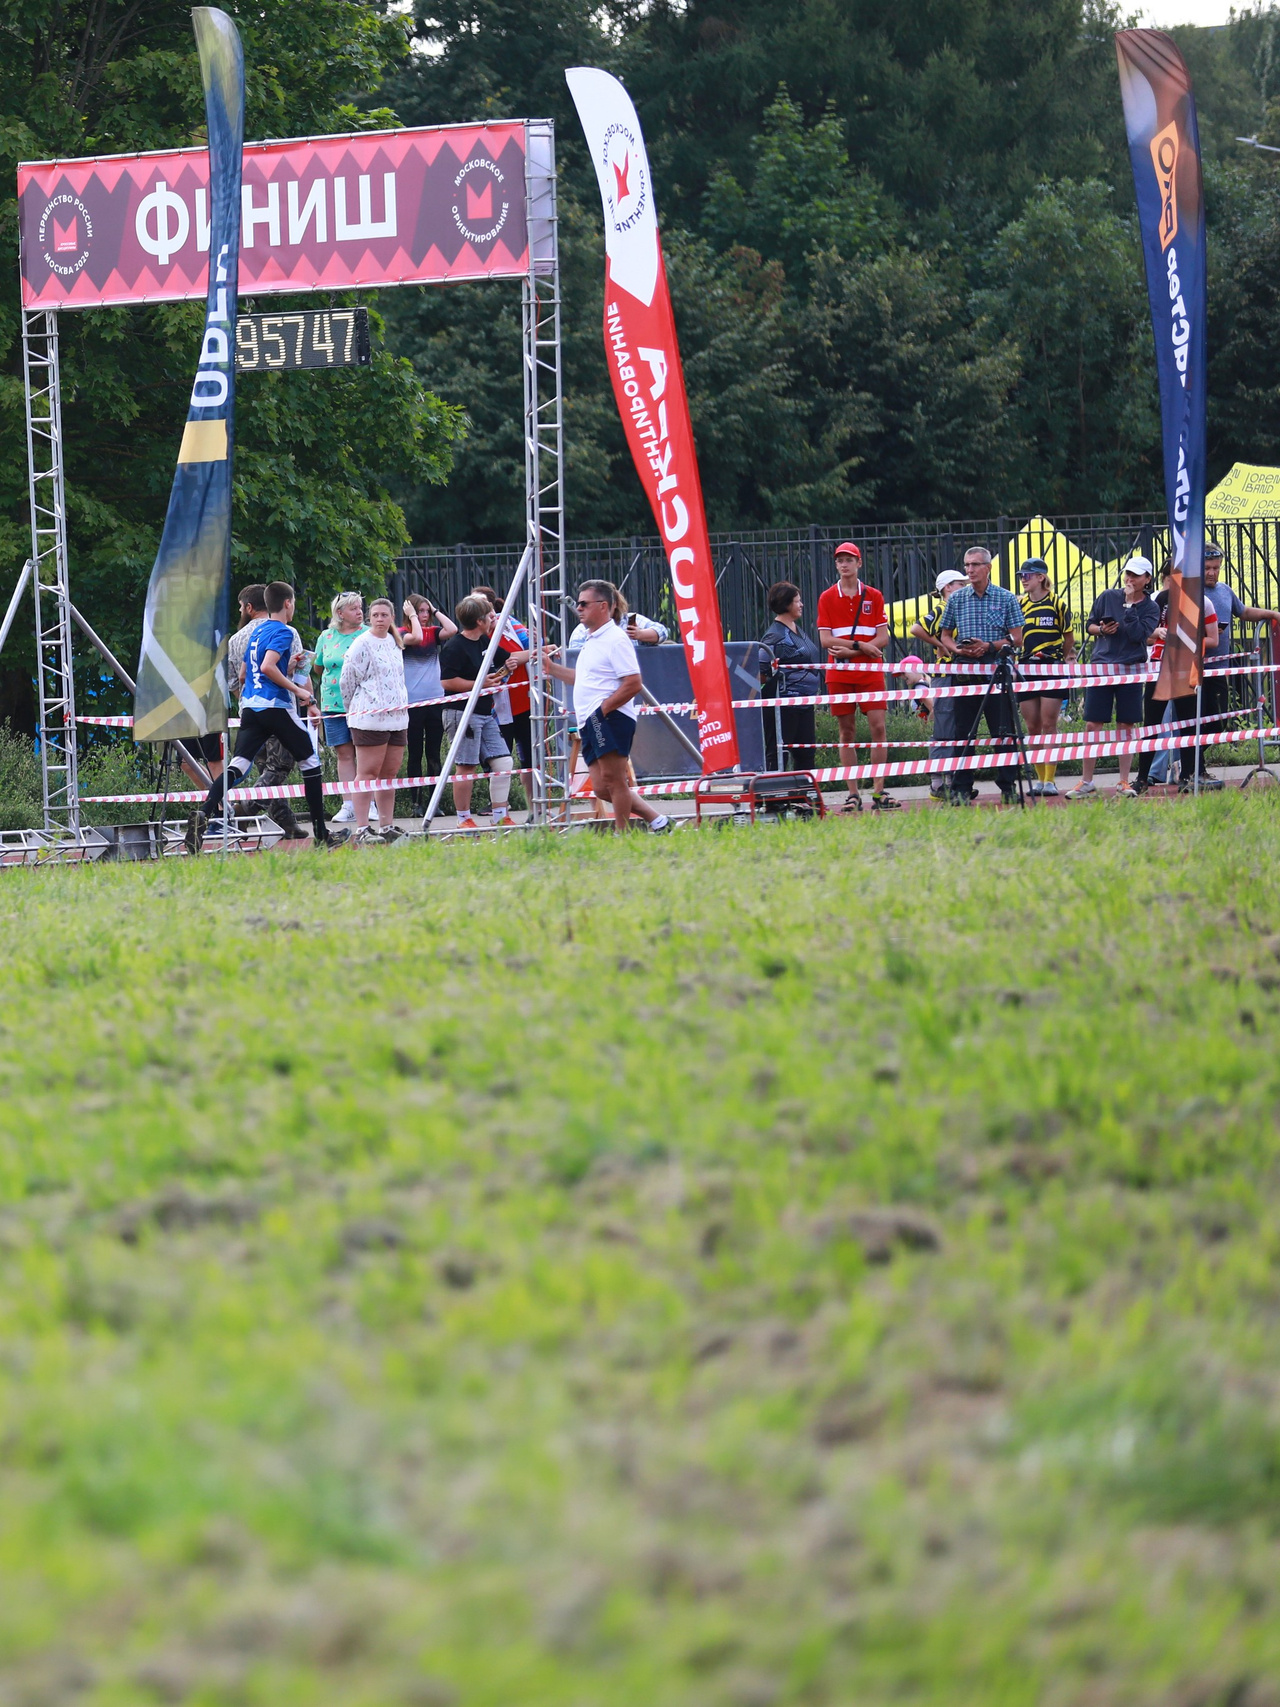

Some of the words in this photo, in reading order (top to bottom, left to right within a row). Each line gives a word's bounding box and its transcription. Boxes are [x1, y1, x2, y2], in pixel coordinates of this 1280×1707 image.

[454, 158, 504, 187] МОСКОВСКОЕ
[39, 194, 73, 242] ПЕРВЕНСТВО
[73, 198, 93, 238] РОССИИ
[451, 201, 509, 243] ОРИЕНТИРОВАНИЕ
[43, 252, 74, 275] МОСКВА
[73, 250, 90, 272] 2026
[250, 637, 263, 689] TEAM
